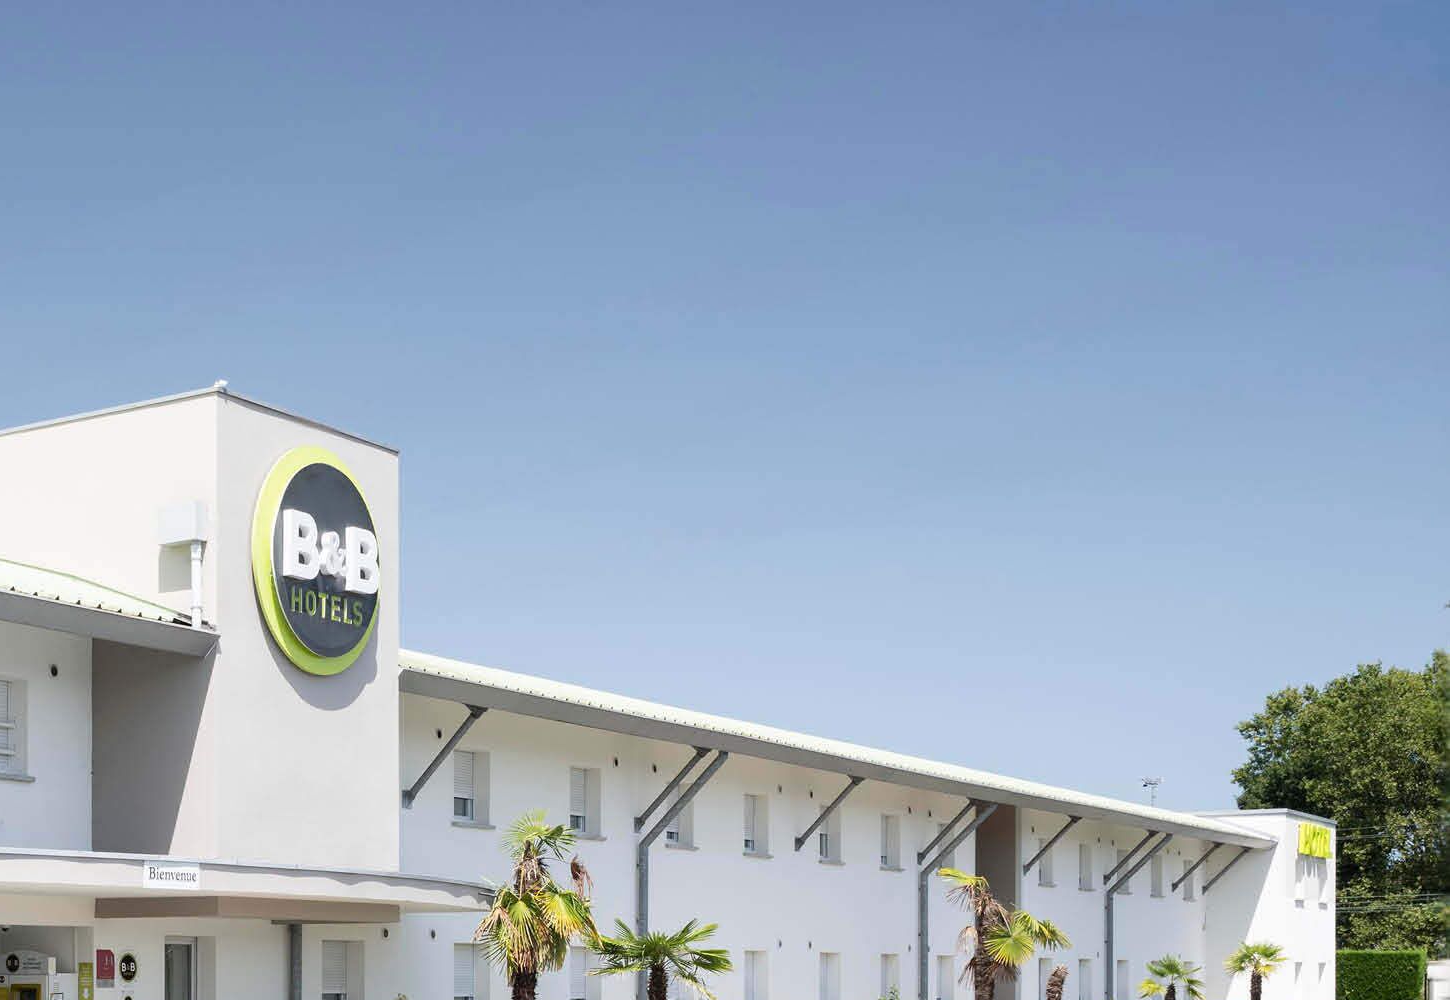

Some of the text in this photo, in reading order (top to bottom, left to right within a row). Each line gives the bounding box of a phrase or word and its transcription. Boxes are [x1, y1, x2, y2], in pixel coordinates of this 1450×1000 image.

[282, 508, 380, 594] B&B
[291, 586, 364, 627] HOTELS
[149, 866, 197, 882] Bienvenue
